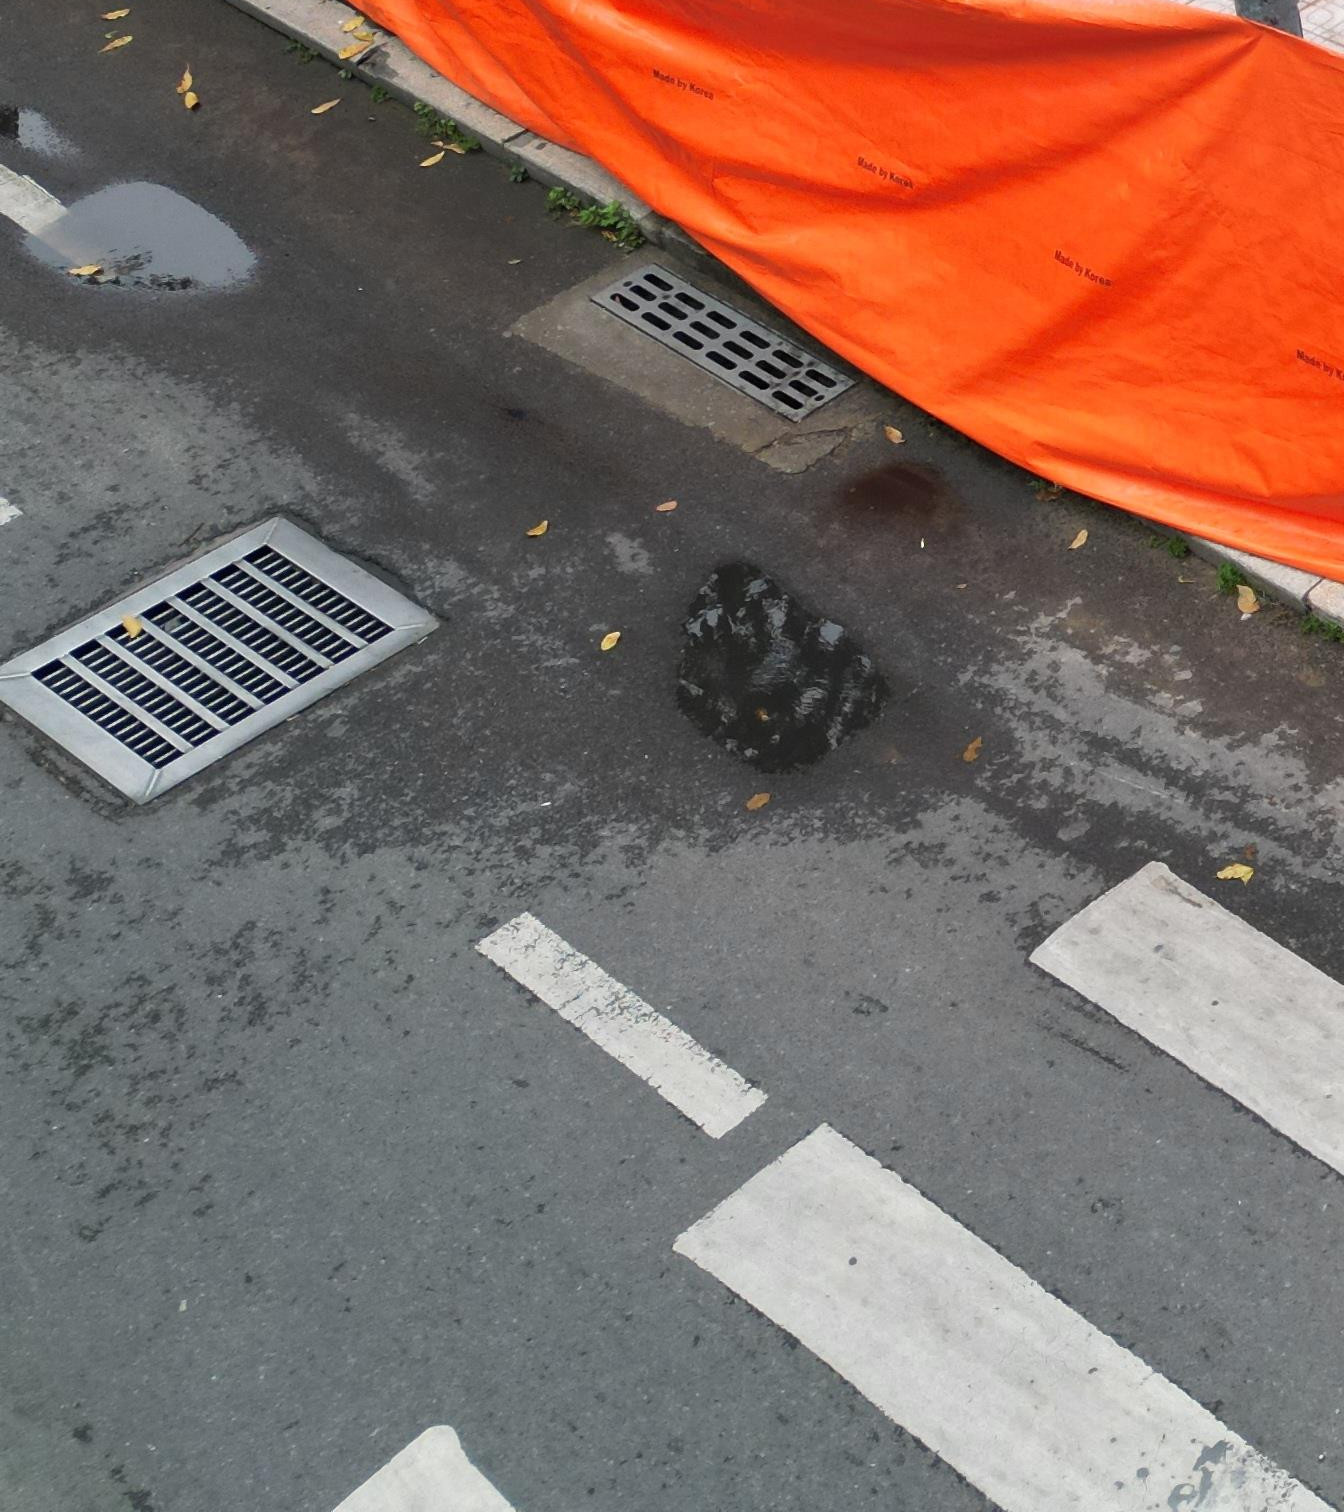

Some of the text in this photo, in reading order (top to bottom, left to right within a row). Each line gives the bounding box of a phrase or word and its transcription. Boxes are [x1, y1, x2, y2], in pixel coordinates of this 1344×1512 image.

[653, 68, 676, 85] Made
[689, 82, 714, 101] Korea
[857, 156, 877, 174] Made
[1055, 249, 1074, 269] Made
[1296, 349, 1321, 368] Made
